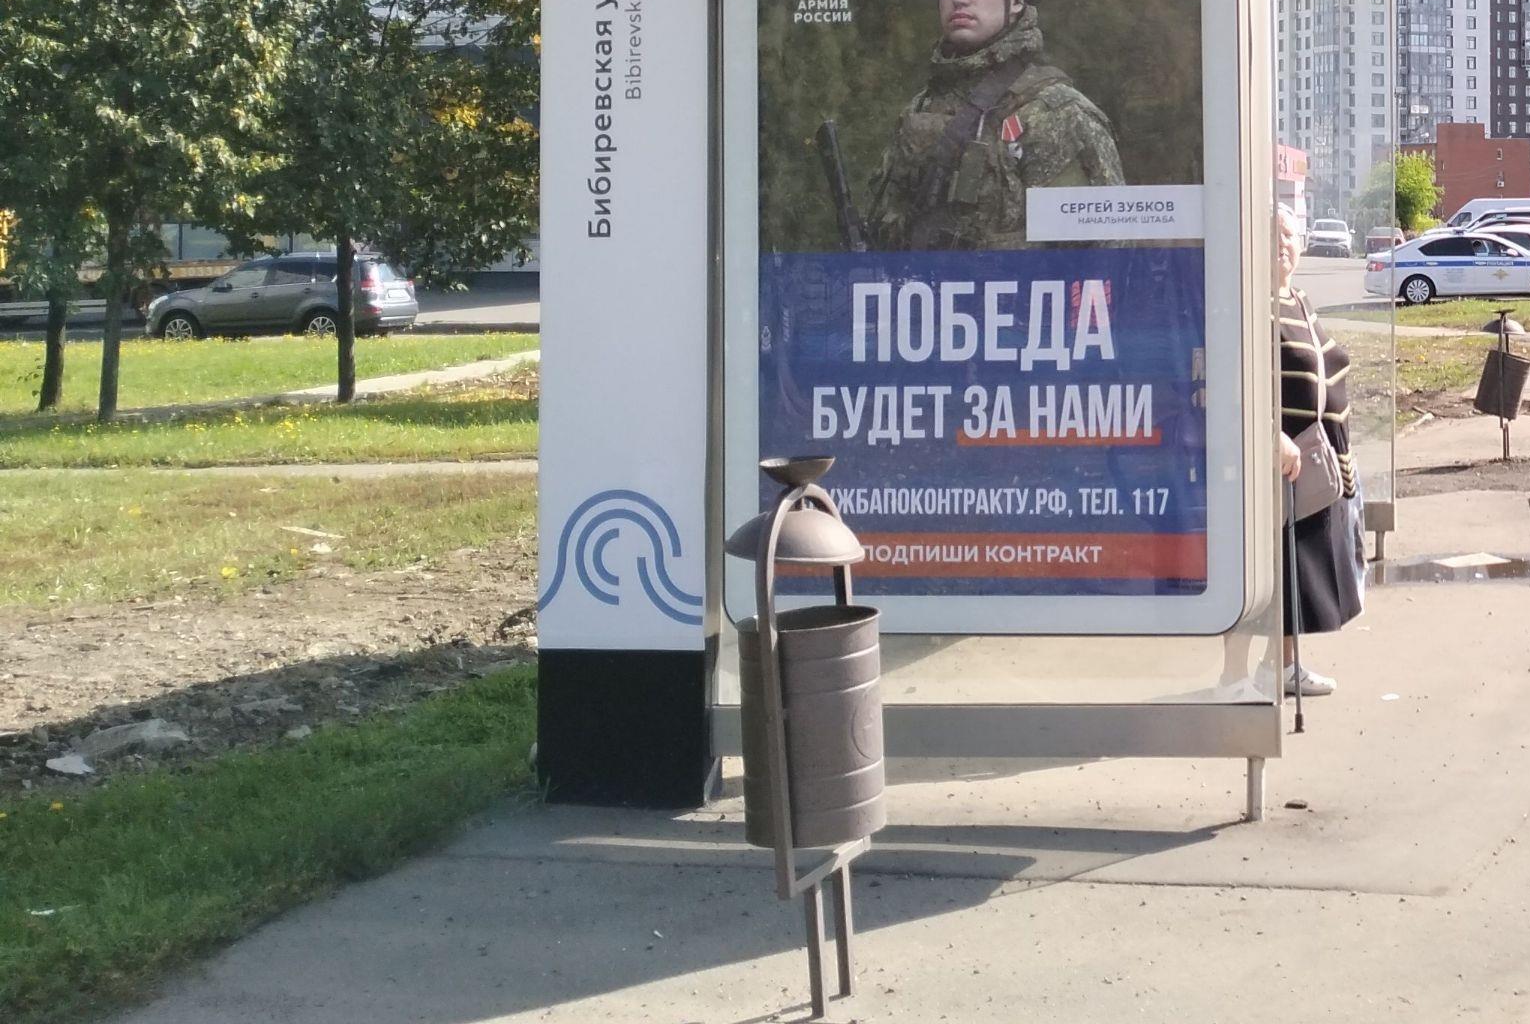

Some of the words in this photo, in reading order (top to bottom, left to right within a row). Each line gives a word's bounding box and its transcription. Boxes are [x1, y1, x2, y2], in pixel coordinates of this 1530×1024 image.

[793, 11, 853, 23] РОССИИ
[587, 20, 617, 238] Бибиревская
[1060, 200, 1113, 214] СЕРГЕЙ
[1117, 201, 1175, 213] ЗУБКОВ
[1077, 216, 1138, 225] НАЧАЛЬНИК
[1141, 215, 1175, 224] ШТАБА
[852, 279, 1115, 371] ПОБЕДА
[812, 385, 952, 446] БУДЕТ
[963, 385, 1016, 439] ЗА
[1029, 384, 1153, 439] НАМИ
[802, 487, 1073, 517] ЖБАПОКОНТРАКТУ.РФ,
[1079, 488, 1123, 515] ТЕЛ.
[1133, 487, 1169, 515] 117
[985, 543, 1102, 564] КОНТРАКТ
